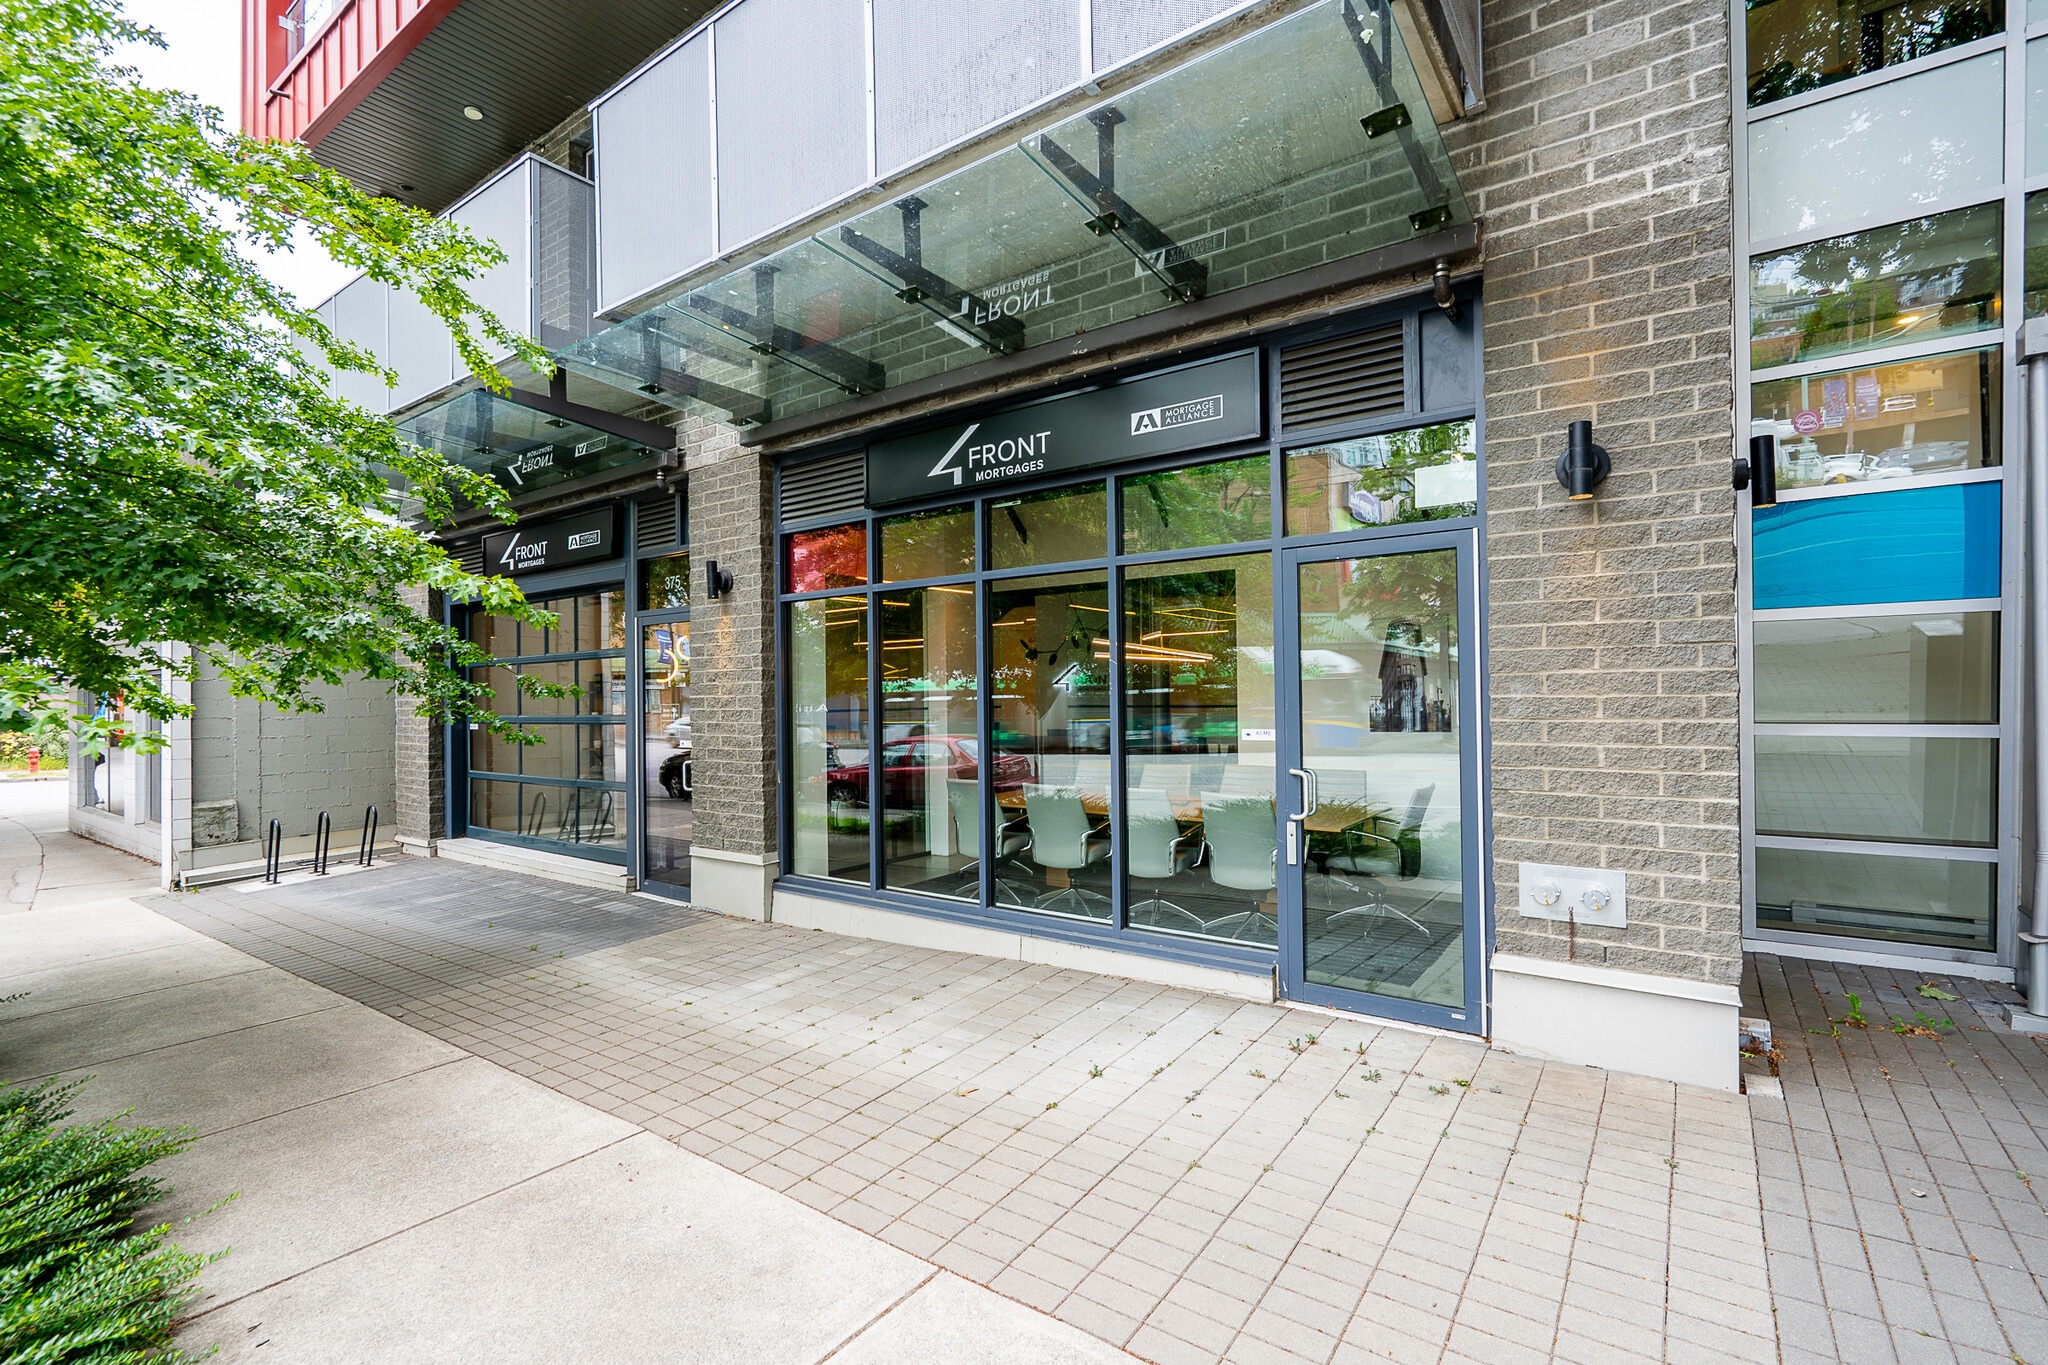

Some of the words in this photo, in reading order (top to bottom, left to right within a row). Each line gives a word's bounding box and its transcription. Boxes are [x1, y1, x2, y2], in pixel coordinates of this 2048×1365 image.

[1165, 400, 1215, 418] MORTGAGE
[1165, 408, 1215, 425] ALLIANCE
[968, 431, 1051, 469] FRONT
[975, 459, 1044, 482] MORTGAGES
[515, 541, 548, 561] FRONT
[518, 558, 545, 569] MORTGAGES
[664, 575, 681, 590] 375
